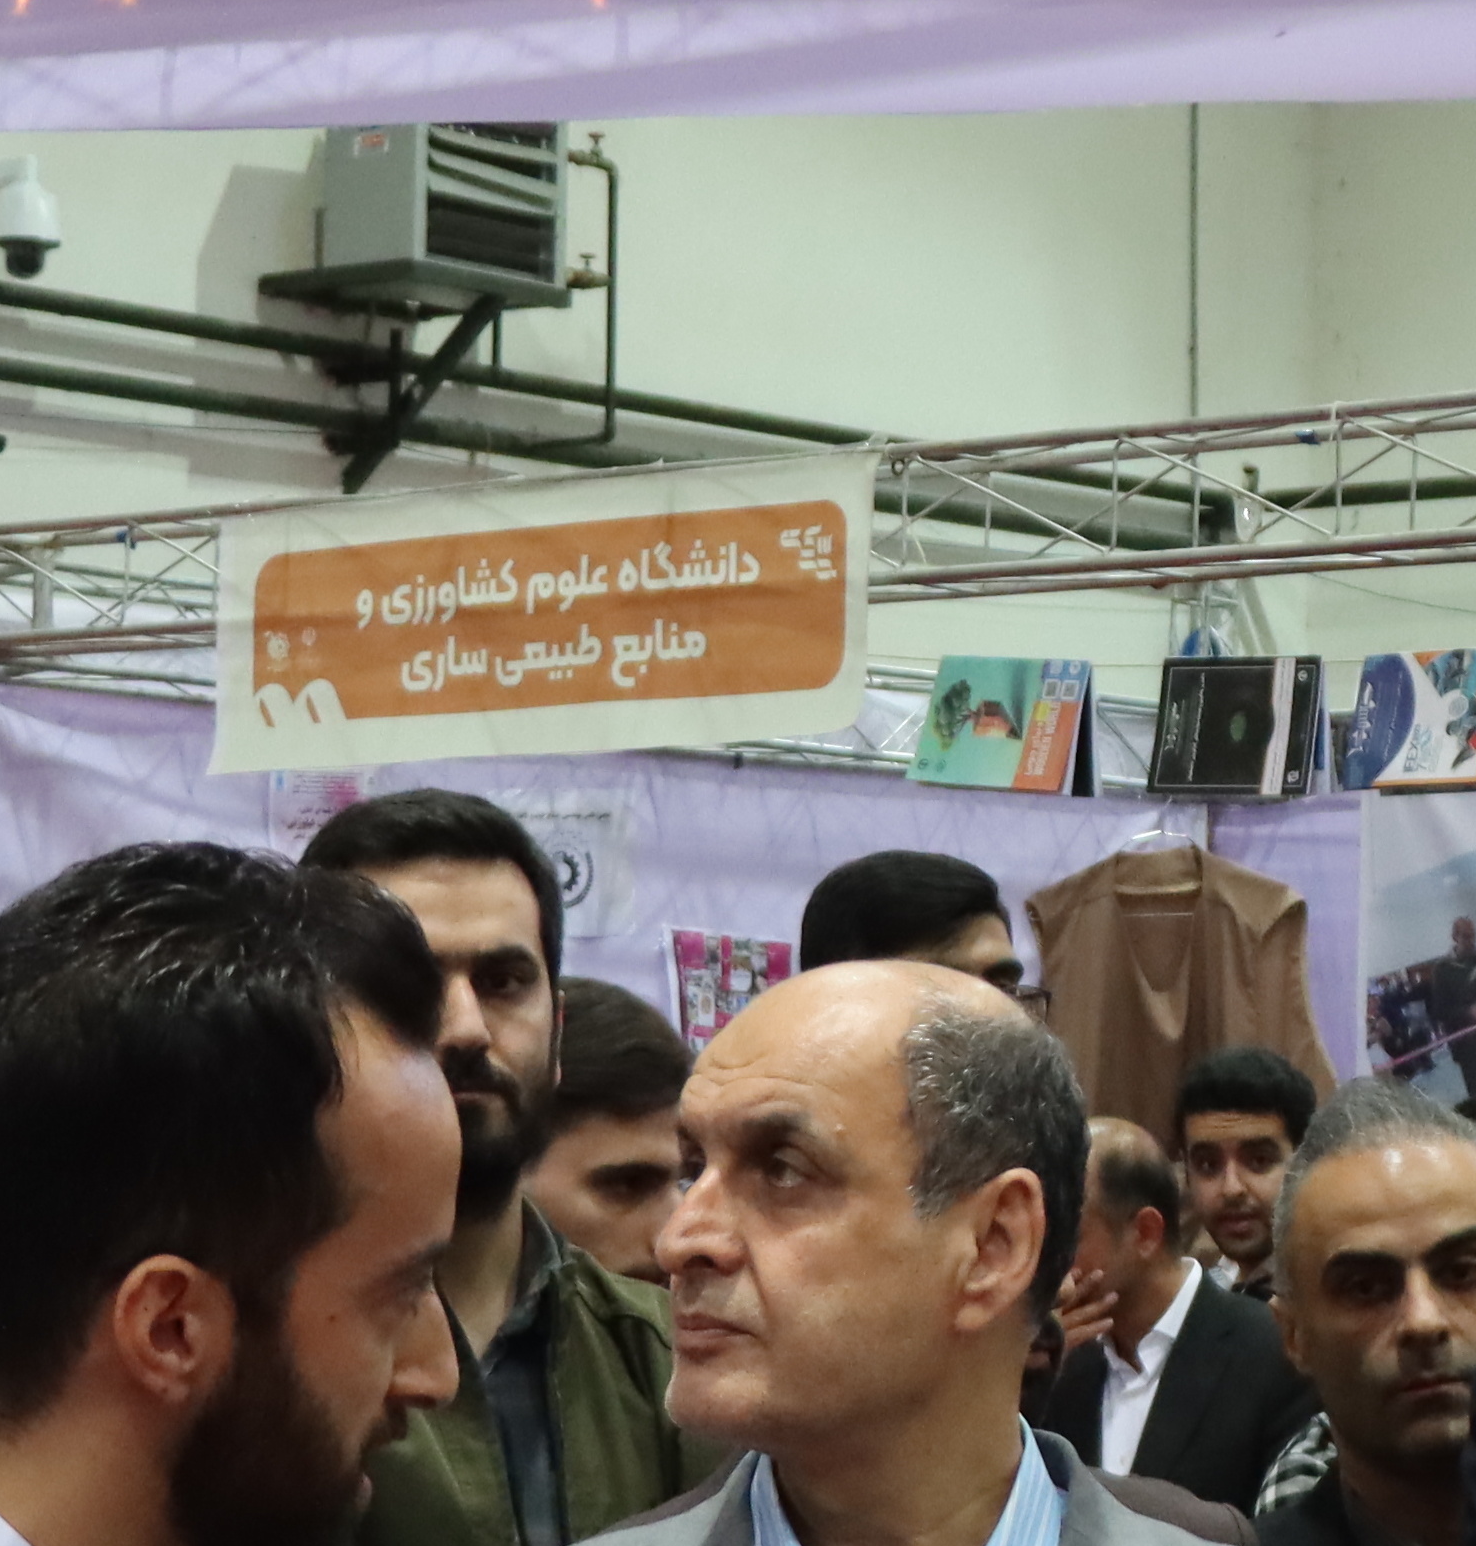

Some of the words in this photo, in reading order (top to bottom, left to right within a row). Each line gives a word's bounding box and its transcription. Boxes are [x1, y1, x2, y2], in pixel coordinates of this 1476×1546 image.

[380, 557, 519, 626] کشاورزی
[525, 553, 609, 615] علوم
[617, 538, 761, 592] دانشگاه
[355, 587, 374, 630] و
[401, 635, 488, 692] ساری
[494, 623, 603, 687] طبیعی
[610, 617, 707, 689] منابع
